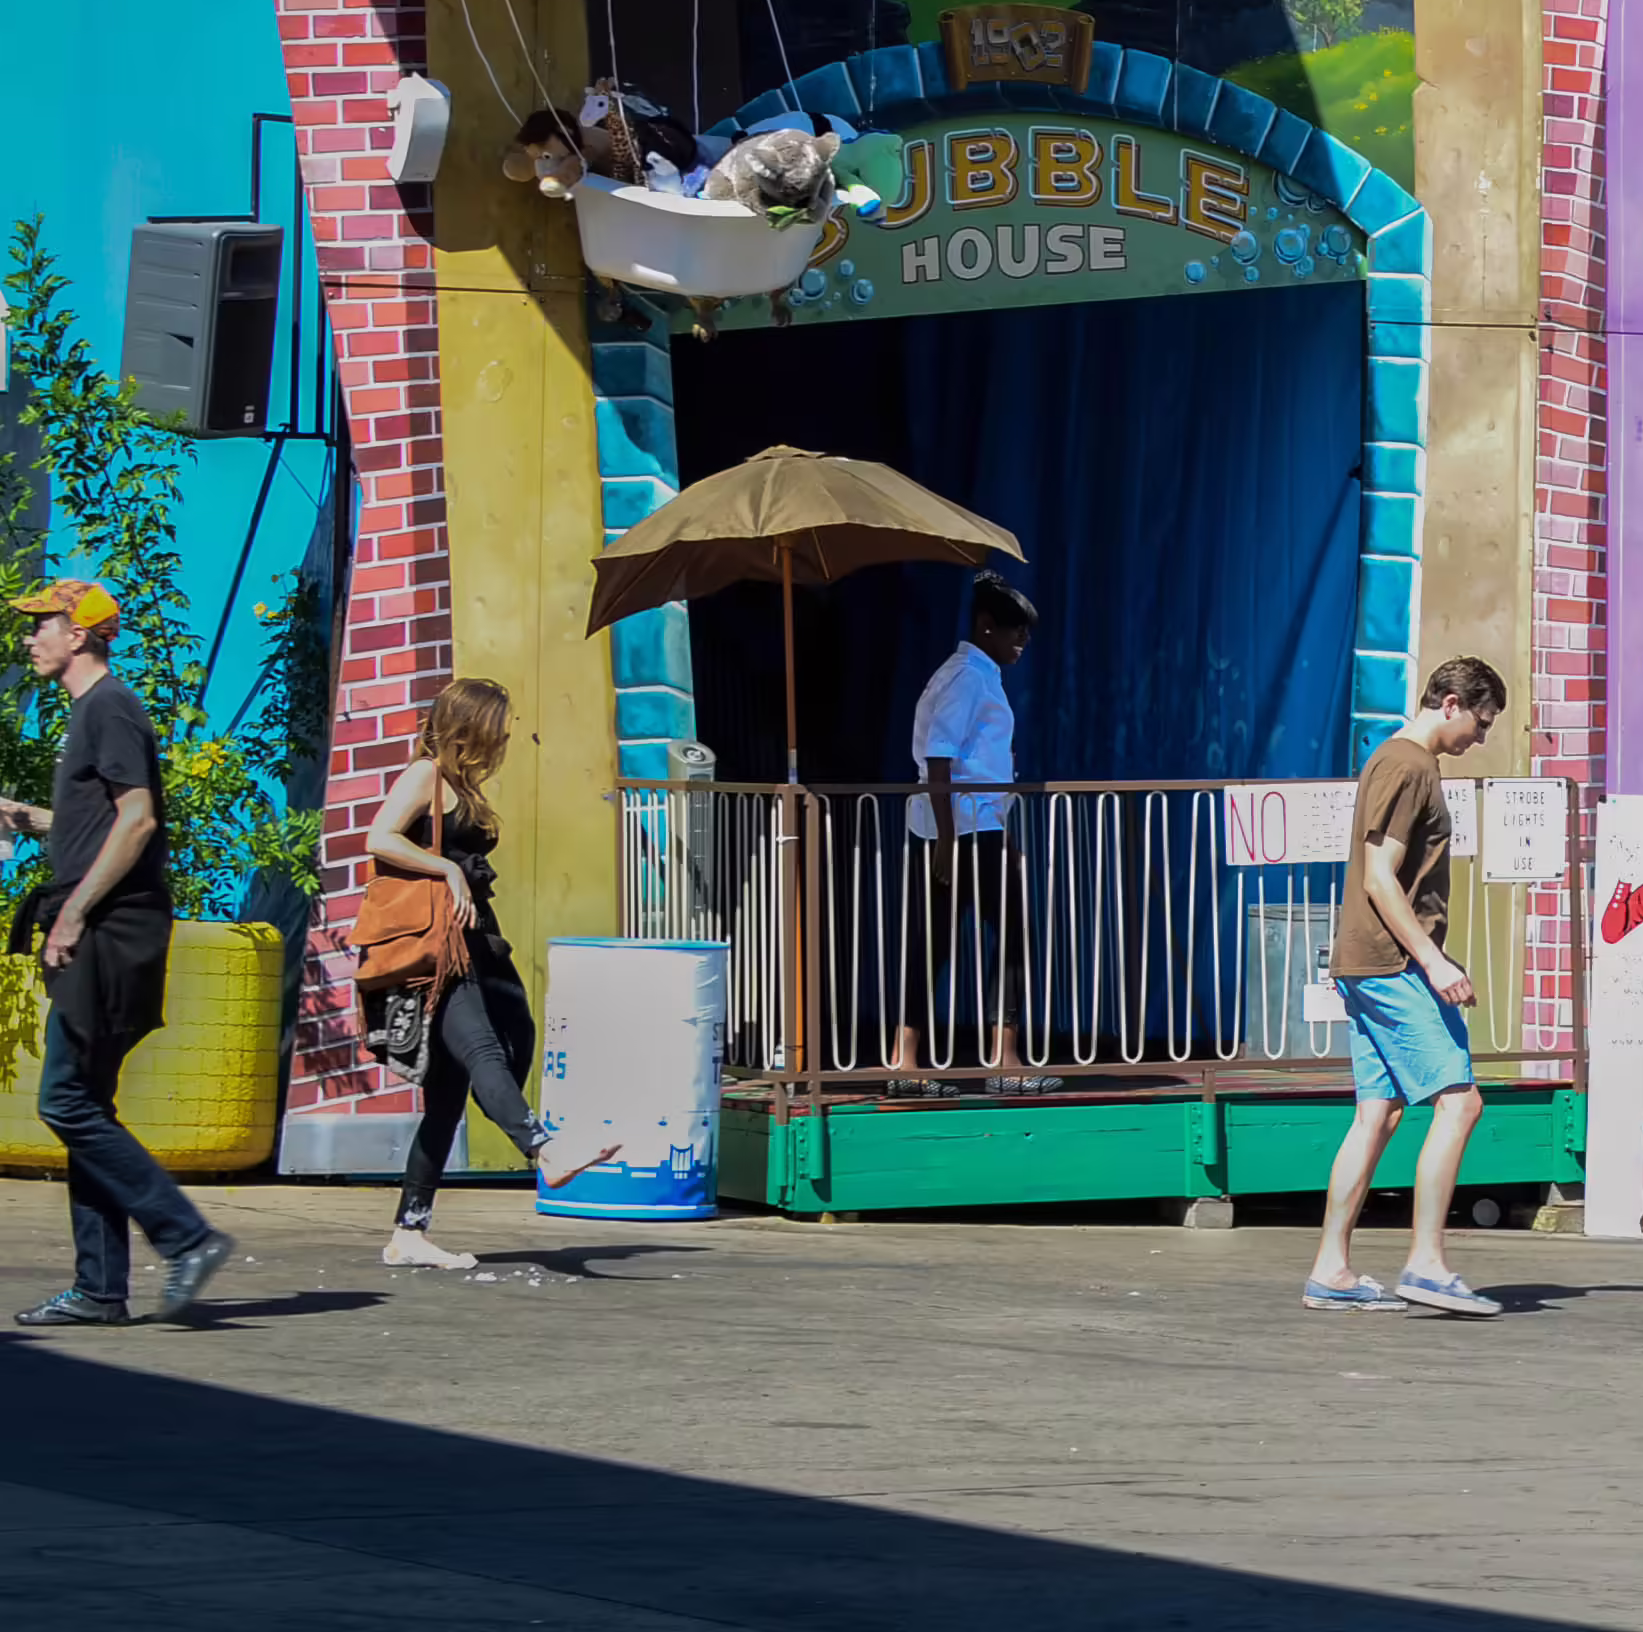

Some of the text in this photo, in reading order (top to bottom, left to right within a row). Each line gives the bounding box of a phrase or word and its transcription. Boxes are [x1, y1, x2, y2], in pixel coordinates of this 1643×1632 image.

[971, 18, 1066, 73] 1902
[806, 125, 1250, 267] UBBLE
[901, 223, 1128, 284] HOUSE
[1505, 791, 1545, 805] STROBE
[1230, 790, 1287, 863] NO
[1503, 813, 1545, 827] LIGHTS
[1519, 836, 1531, 848] IN
[1513, 857, 1533, 870] USE
